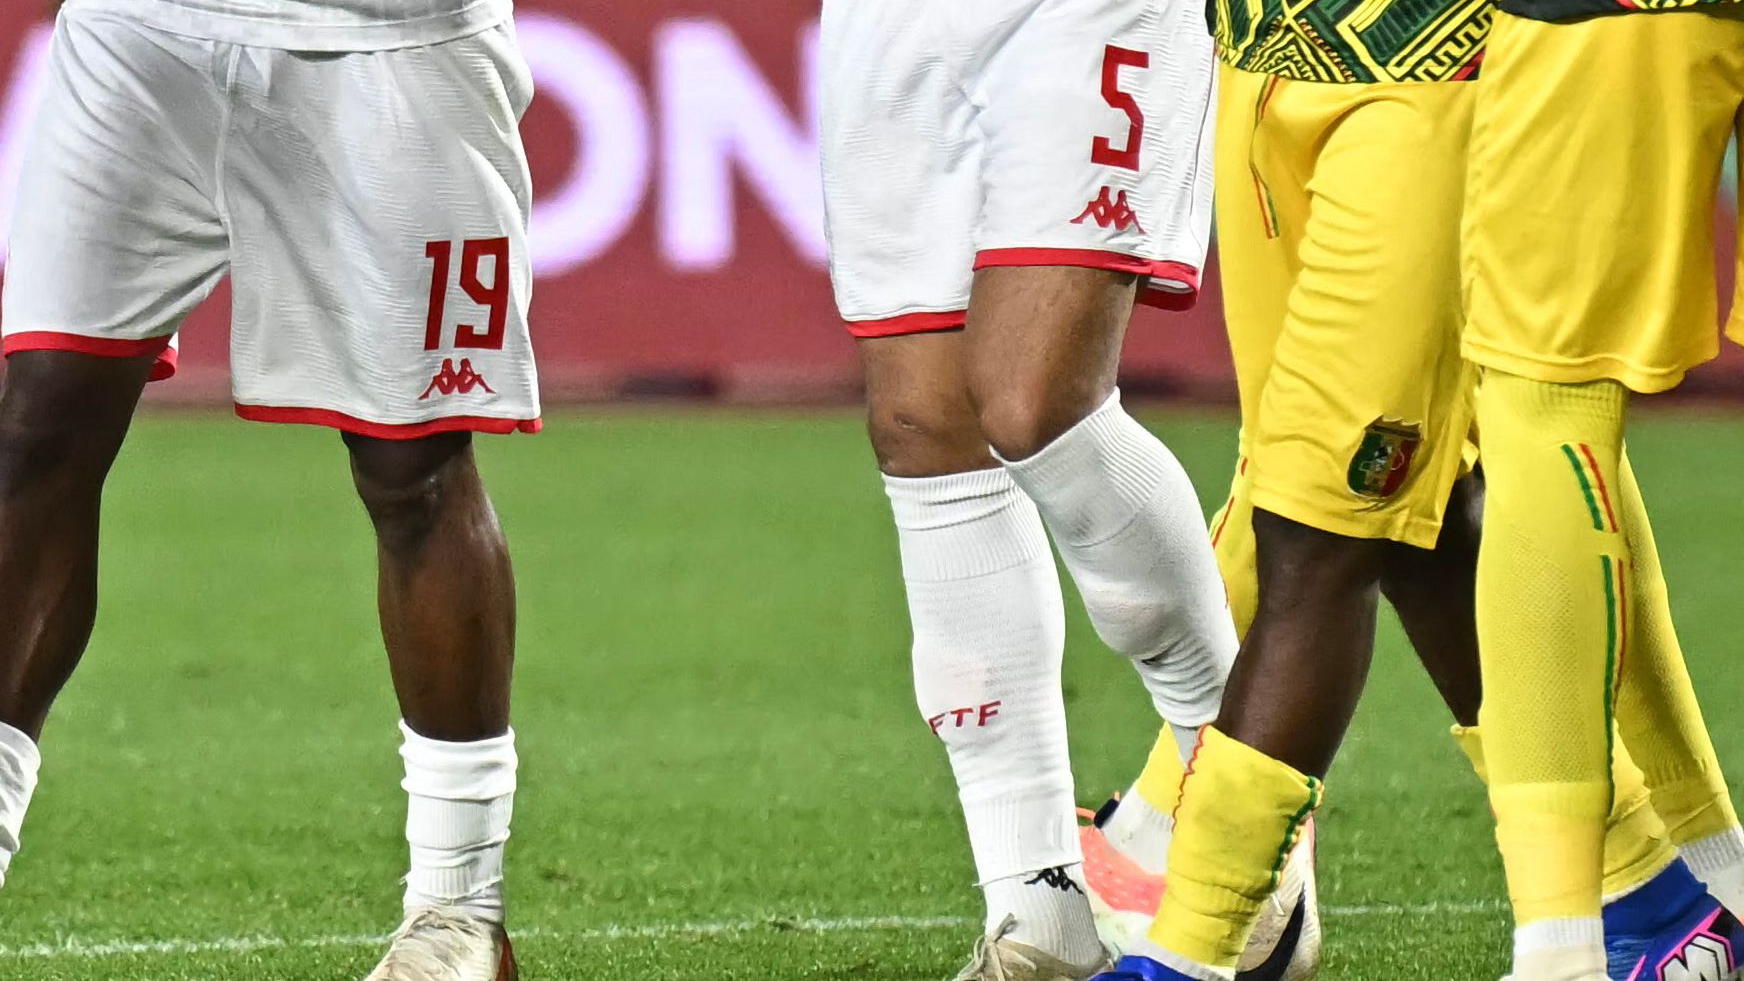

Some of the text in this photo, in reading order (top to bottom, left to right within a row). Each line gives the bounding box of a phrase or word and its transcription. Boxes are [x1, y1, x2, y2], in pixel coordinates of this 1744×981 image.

[1091, 44, 1149, 172] 5
[424, 236, 510, 351] 19
[928, 700, 1002, 735] FTF
